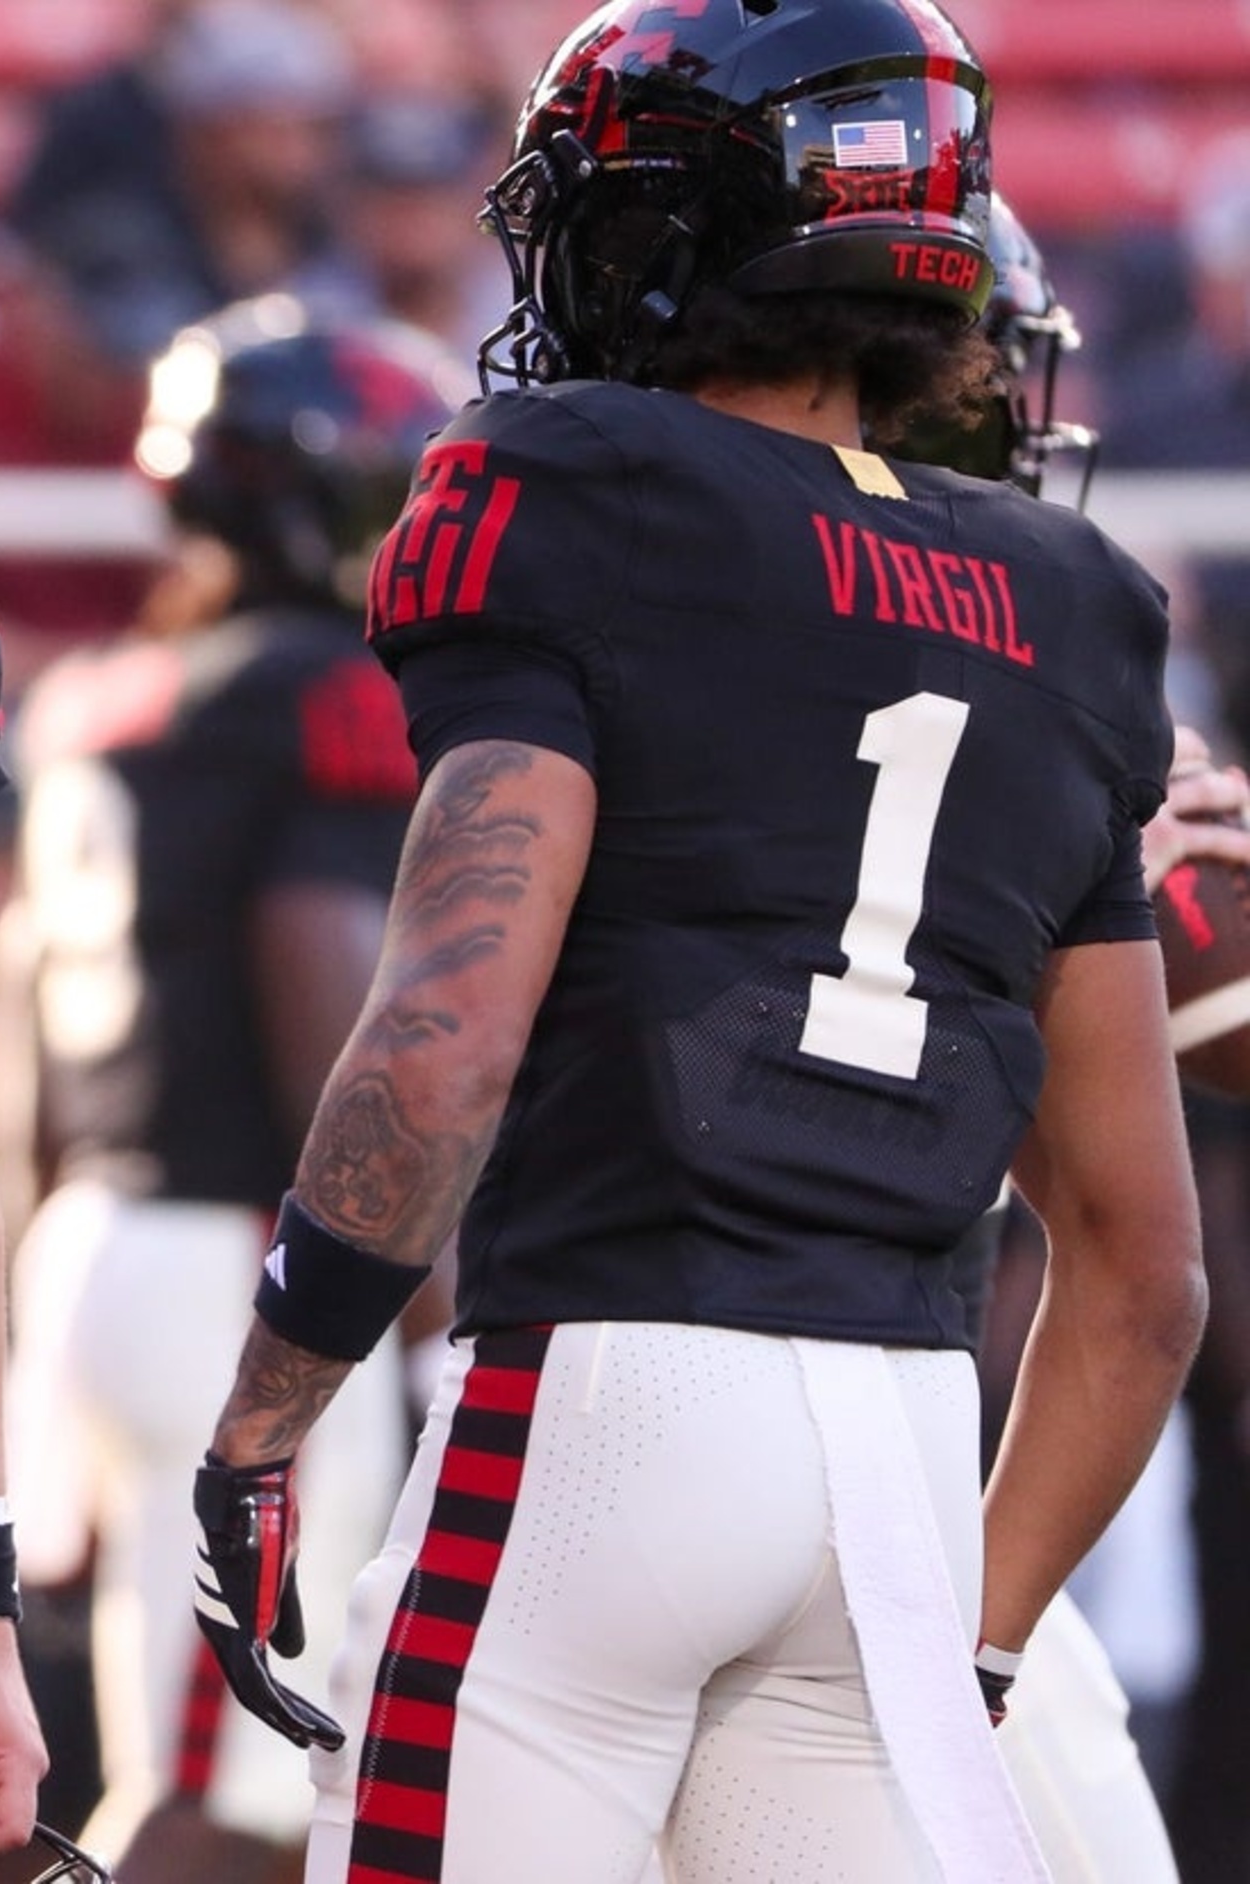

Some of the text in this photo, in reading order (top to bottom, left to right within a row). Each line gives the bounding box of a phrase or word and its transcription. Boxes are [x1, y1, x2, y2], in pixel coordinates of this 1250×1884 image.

[888, 243, 981, 290] TECH
[811, 512, 1035, 667] VIRGIL
[798, 691, 969, 1080] 1
